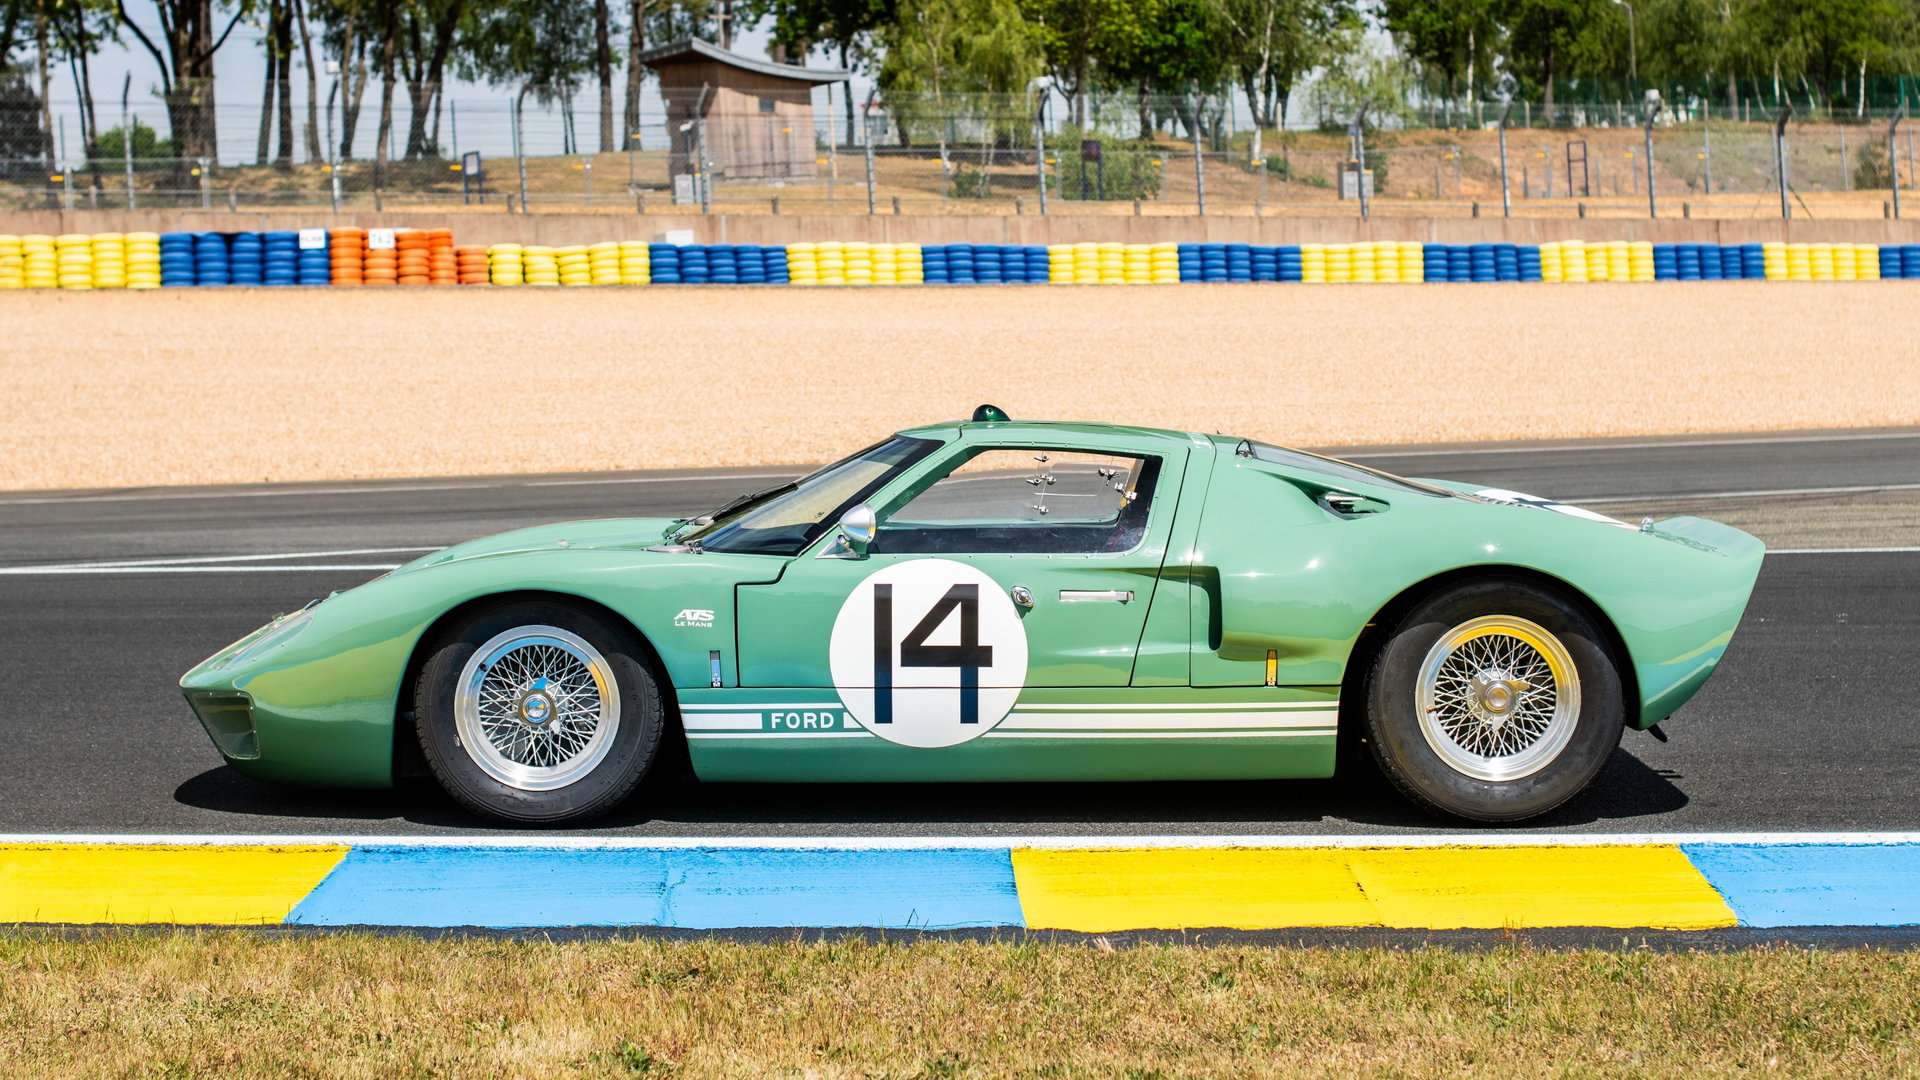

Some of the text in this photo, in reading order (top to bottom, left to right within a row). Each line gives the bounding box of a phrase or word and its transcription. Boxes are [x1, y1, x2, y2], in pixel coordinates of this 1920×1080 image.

[674, 609, 714, 621] ATS
[873, 583, 993, 724] 14
[771, 712, 834, 729] FORD
